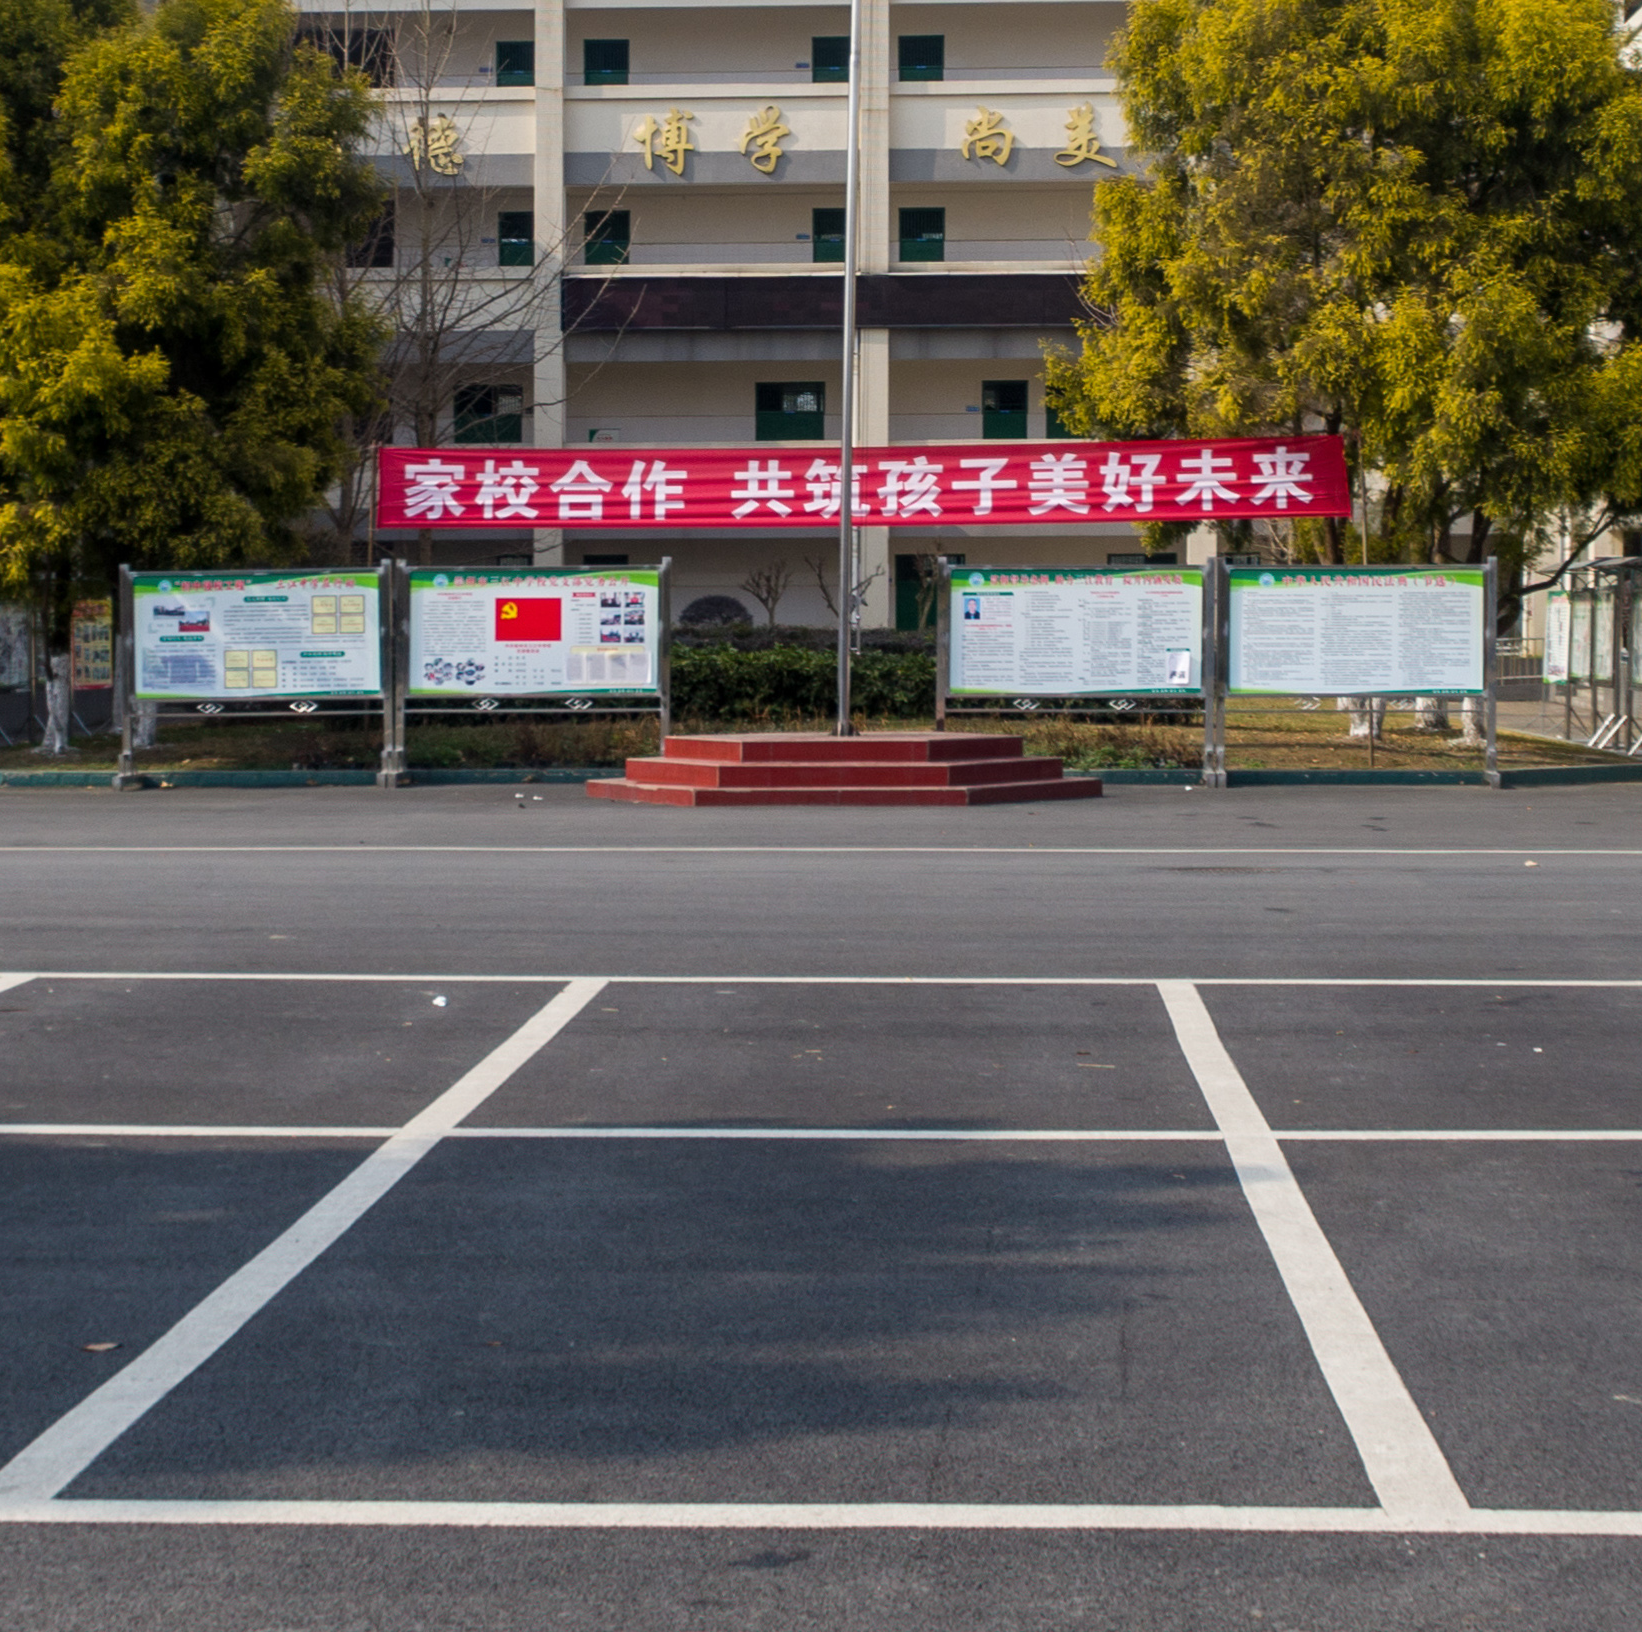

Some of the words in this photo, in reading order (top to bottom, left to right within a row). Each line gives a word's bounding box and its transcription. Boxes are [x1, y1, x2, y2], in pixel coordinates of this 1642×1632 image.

[634, 106, 791, 175] 博学
[962, 101, 1118, 168] 尚美
[404, 459, 688, 521] 家校合作
[730, 446, 1314, 519] 共筑孩子美好未来
